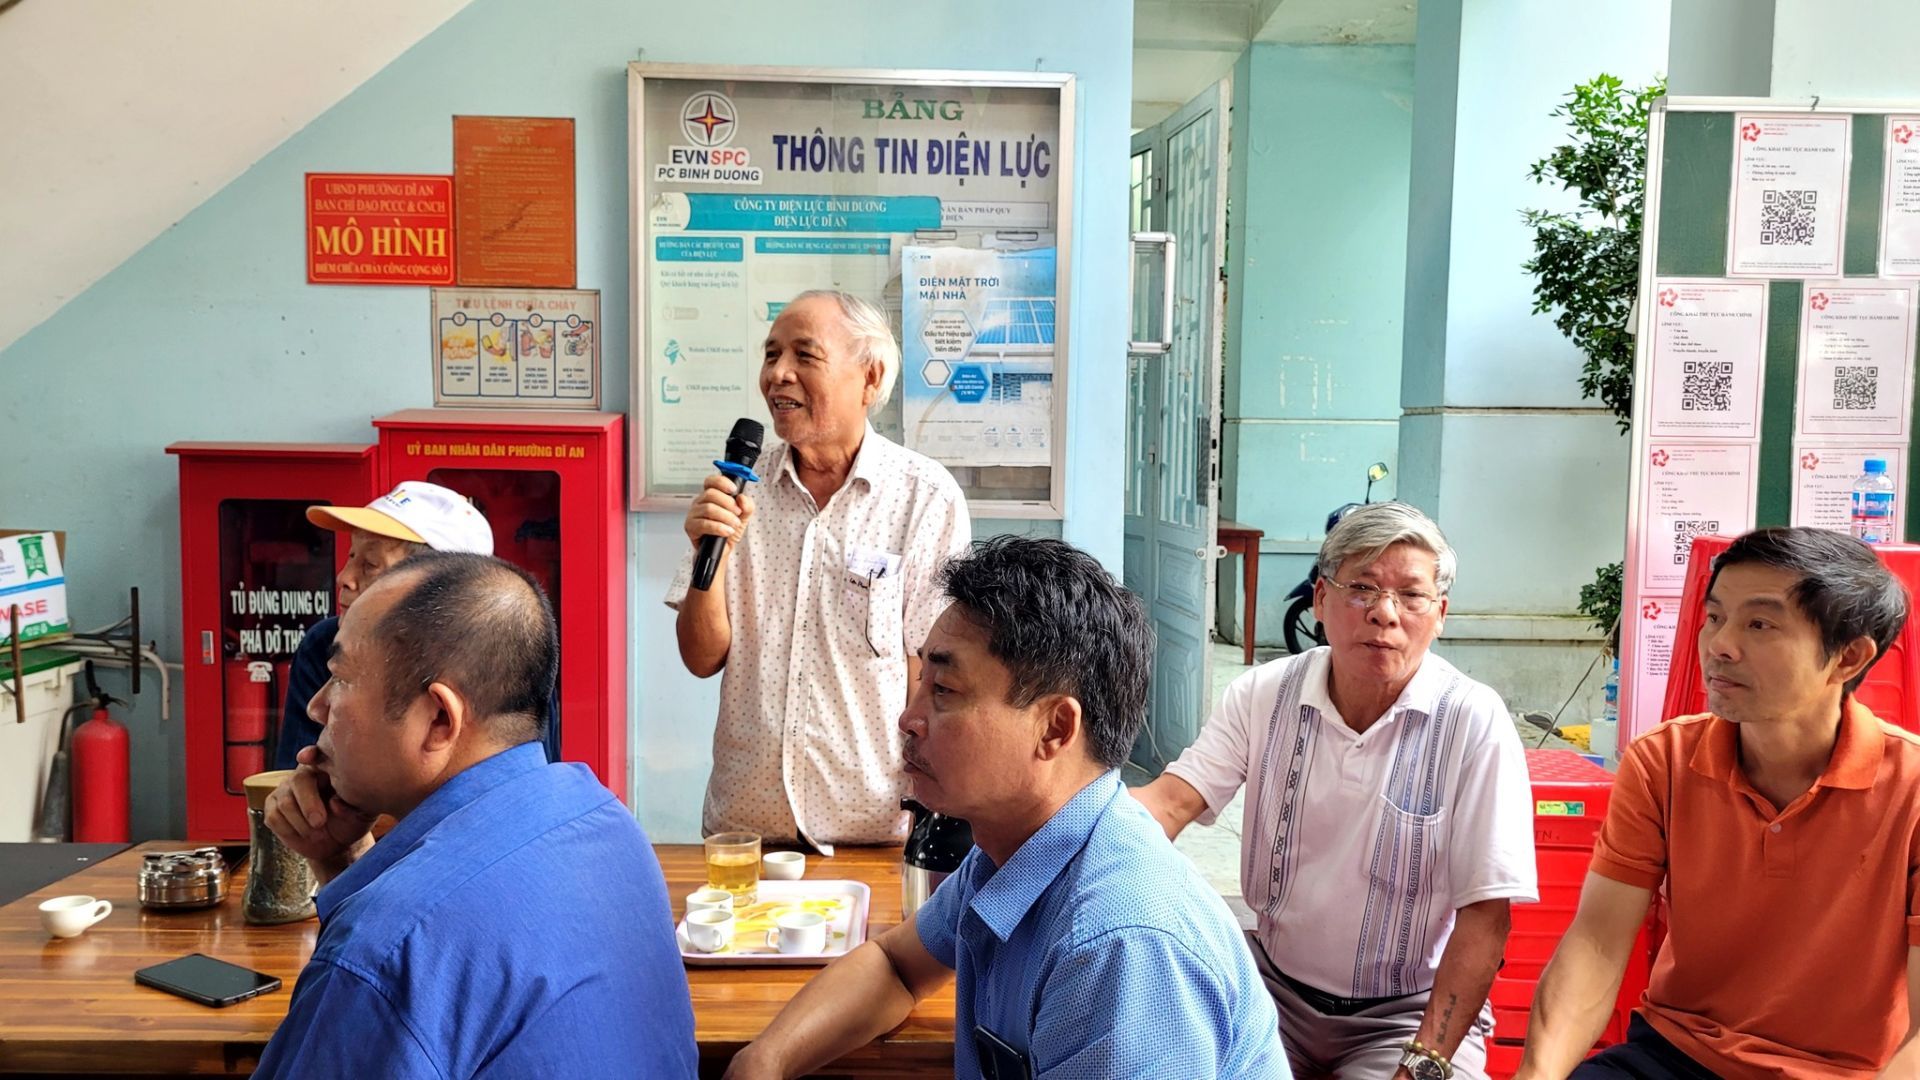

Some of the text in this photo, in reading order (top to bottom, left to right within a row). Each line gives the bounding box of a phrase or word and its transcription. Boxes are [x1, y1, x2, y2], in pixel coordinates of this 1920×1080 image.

[862, 92, 963, 121] BẢNG
[773, 127, 1051, 188] THÔNG TIN ĐIỆN LỰC
[658, 168, 760, 181] PC BINH DUONG
[735, 197, 887, 213] CÔNG TY ĐIỆN LỰC BÌNH DƯƠNG
[315, 217, 447, 257] MÔ HÌNH
[230, 581, 329, 619] TỦ ĐỰNG DỤNG CỤ
[240, 623, 263, 654] PHÁ
